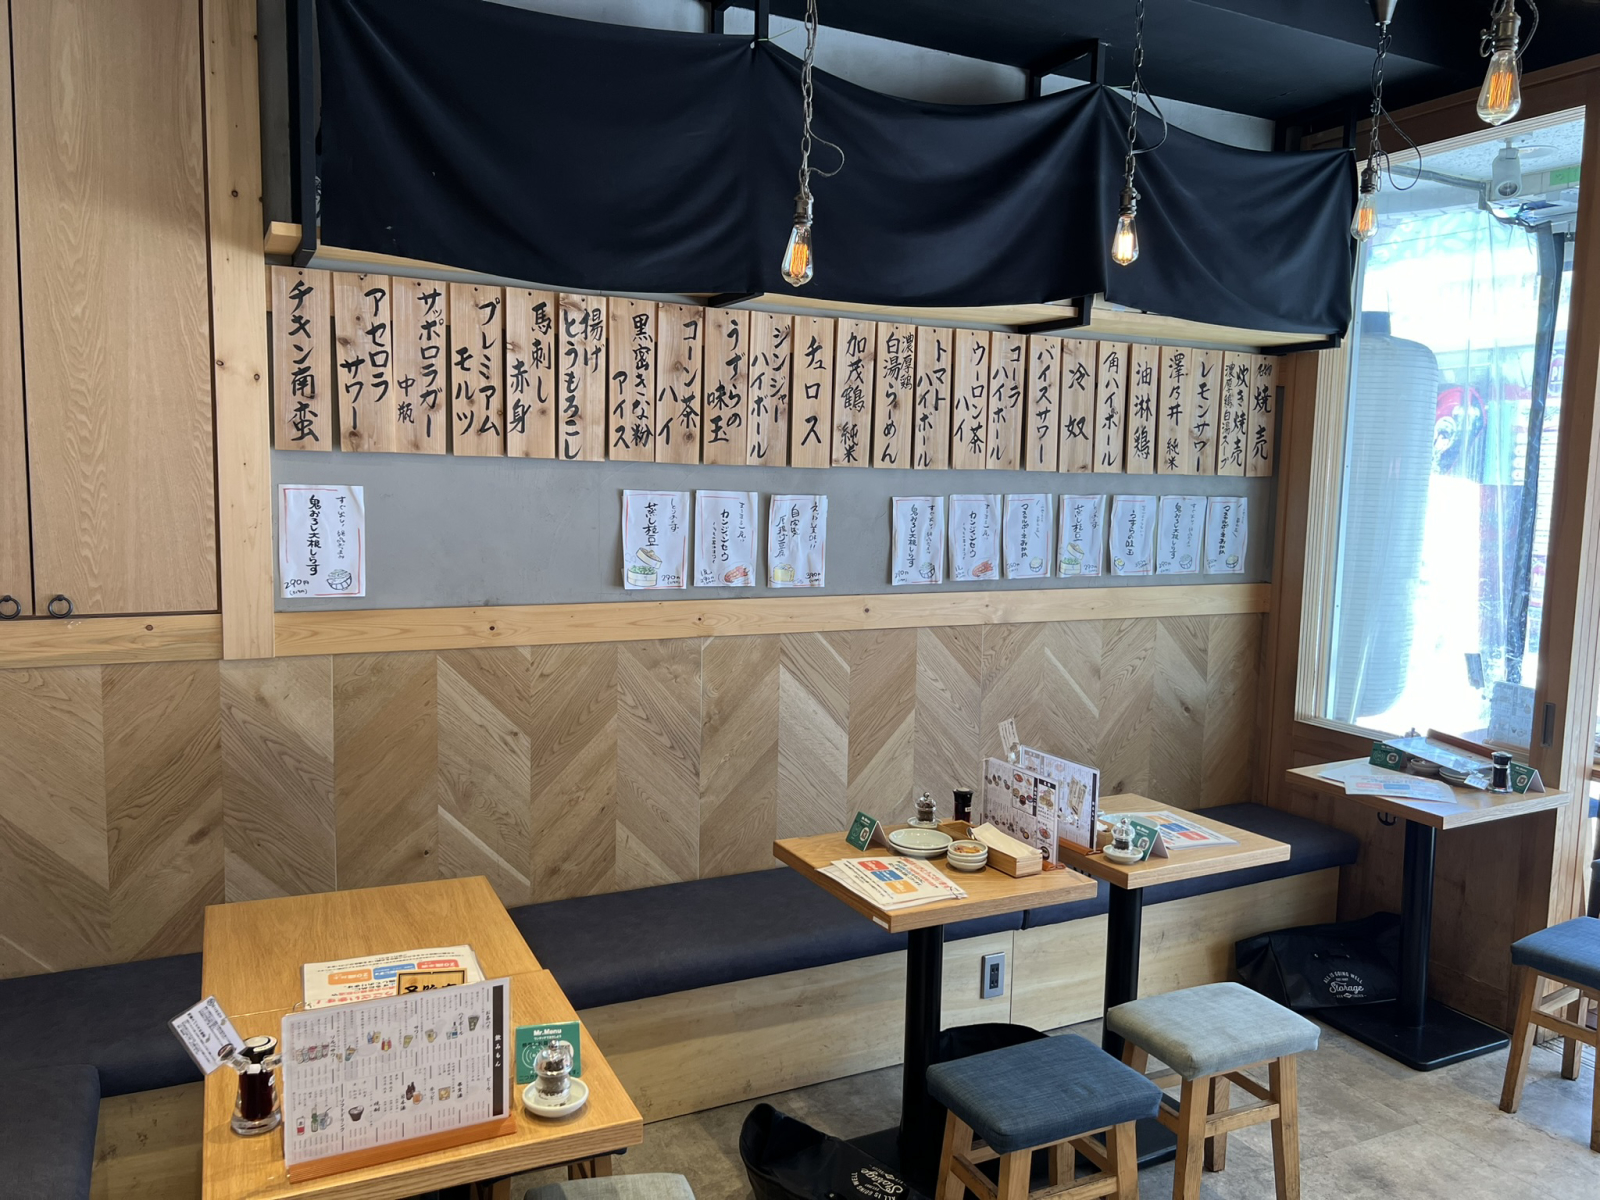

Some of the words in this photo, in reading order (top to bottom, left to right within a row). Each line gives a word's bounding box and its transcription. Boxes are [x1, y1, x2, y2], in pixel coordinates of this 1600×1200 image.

[286, 278, 320, 442] チキン南蛮
[364, 287, 390, 402] アセロラ
[417, 288, 445, 438] サッポロラガー
[478, 296, 501, 436] プレミアム
[529, 301, 552, 404] 馬刺し
[562, 308, 581, 461] とうもろこし
[579, 308, 605, 374] 揚げ
[678, 319, 700, 430] コーン茶
[725, 319, 746, 429] うずらの
[769, 324, 791, 424] ジンジャー
[840, 331, 868, 414] 加茂鶴
[932, 339, 947, 412] トマト
[1008, 345, 1022, 409] コーラ
[339, 355, 366, 431] サワー
[397, 374, 416, 424] 中瓶
[454, 346, 476, 436] モルツ
[508, 357, 532, 434] 赤身
[612, 370, 631, 450] アイス
[657, 384, 680, 446] ハイ
[706, 379, 730, 444] 味玉
[749, 351, 770, 460] ハイボール
[800, 335, 827, 447] チュロス
[880, 331, 901, 465] 白湯らーめん
[917, 371, 933, 468] ハイボール
[954, 394, 970, 443] ハイ
[969, 340, 986, 455] ウーロン茶
[989, 364, 1009, 461] ハイボール
[1035, 344, 1056, 464] バイスサワー
[1064, 361, 1091, 441] 冷奴
[1101, 350, 1120, 467] 角ハイボール
[1132, 360, 1153, 461] 油淋鶏
[1193, 361, 1216, 473] レモンサワー
[1229, 363, 1250, 468] 炊き焼売
[840, 421, 860, 464] 純米
[642, 501, 660, 547] 蒸し枝豆
[1329, 981, 1365, 995] Storage
[850, 1171, 860, 1186] WELL
[856, 1185, 874, 1196] GOING
[860, 1167, 904, 1194] Storage
